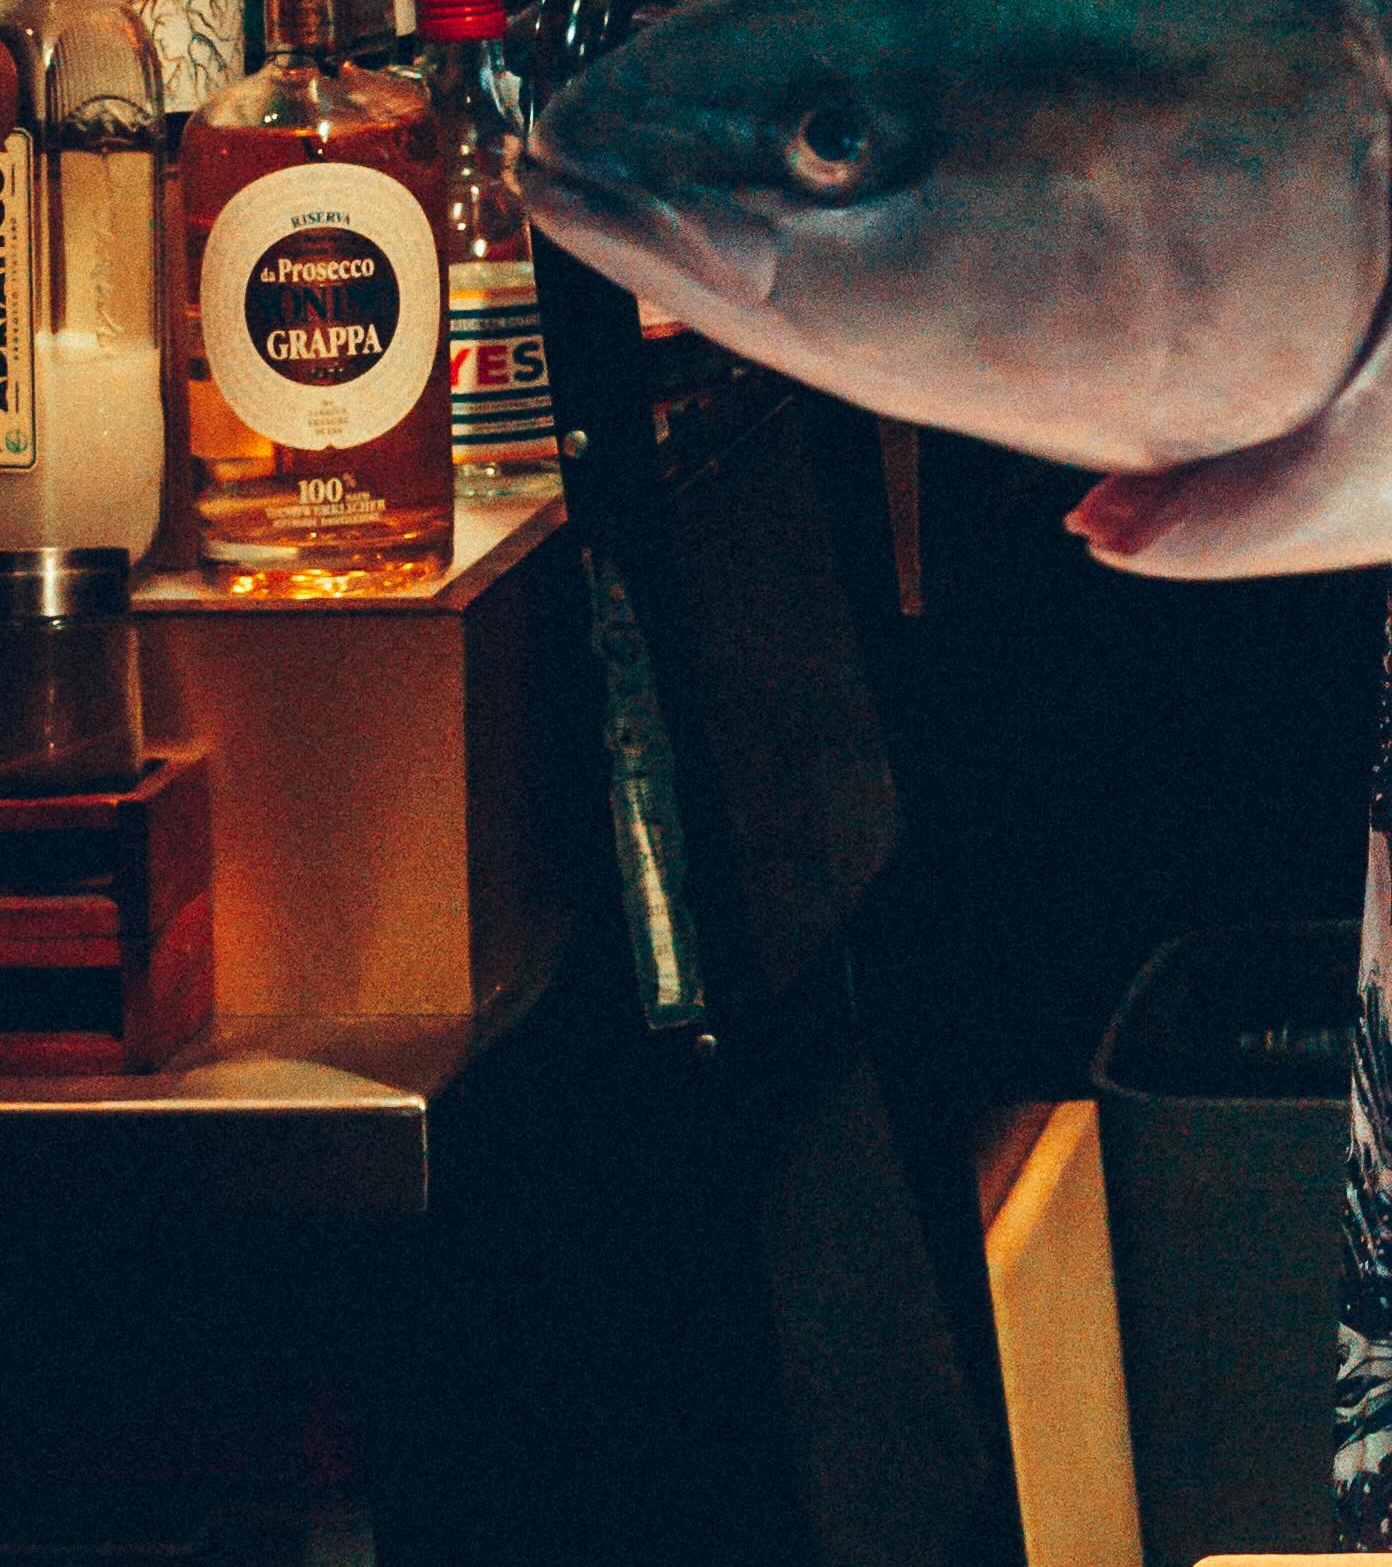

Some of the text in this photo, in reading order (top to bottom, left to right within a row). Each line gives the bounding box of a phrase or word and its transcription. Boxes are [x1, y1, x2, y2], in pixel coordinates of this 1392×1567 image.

[290, 210, 351, 228] RISERVA
[260, 257, 375, 284] da Prosecco
[266, 323, 384, 361] GRAPPA
[450, 341, 546, 388] YES
